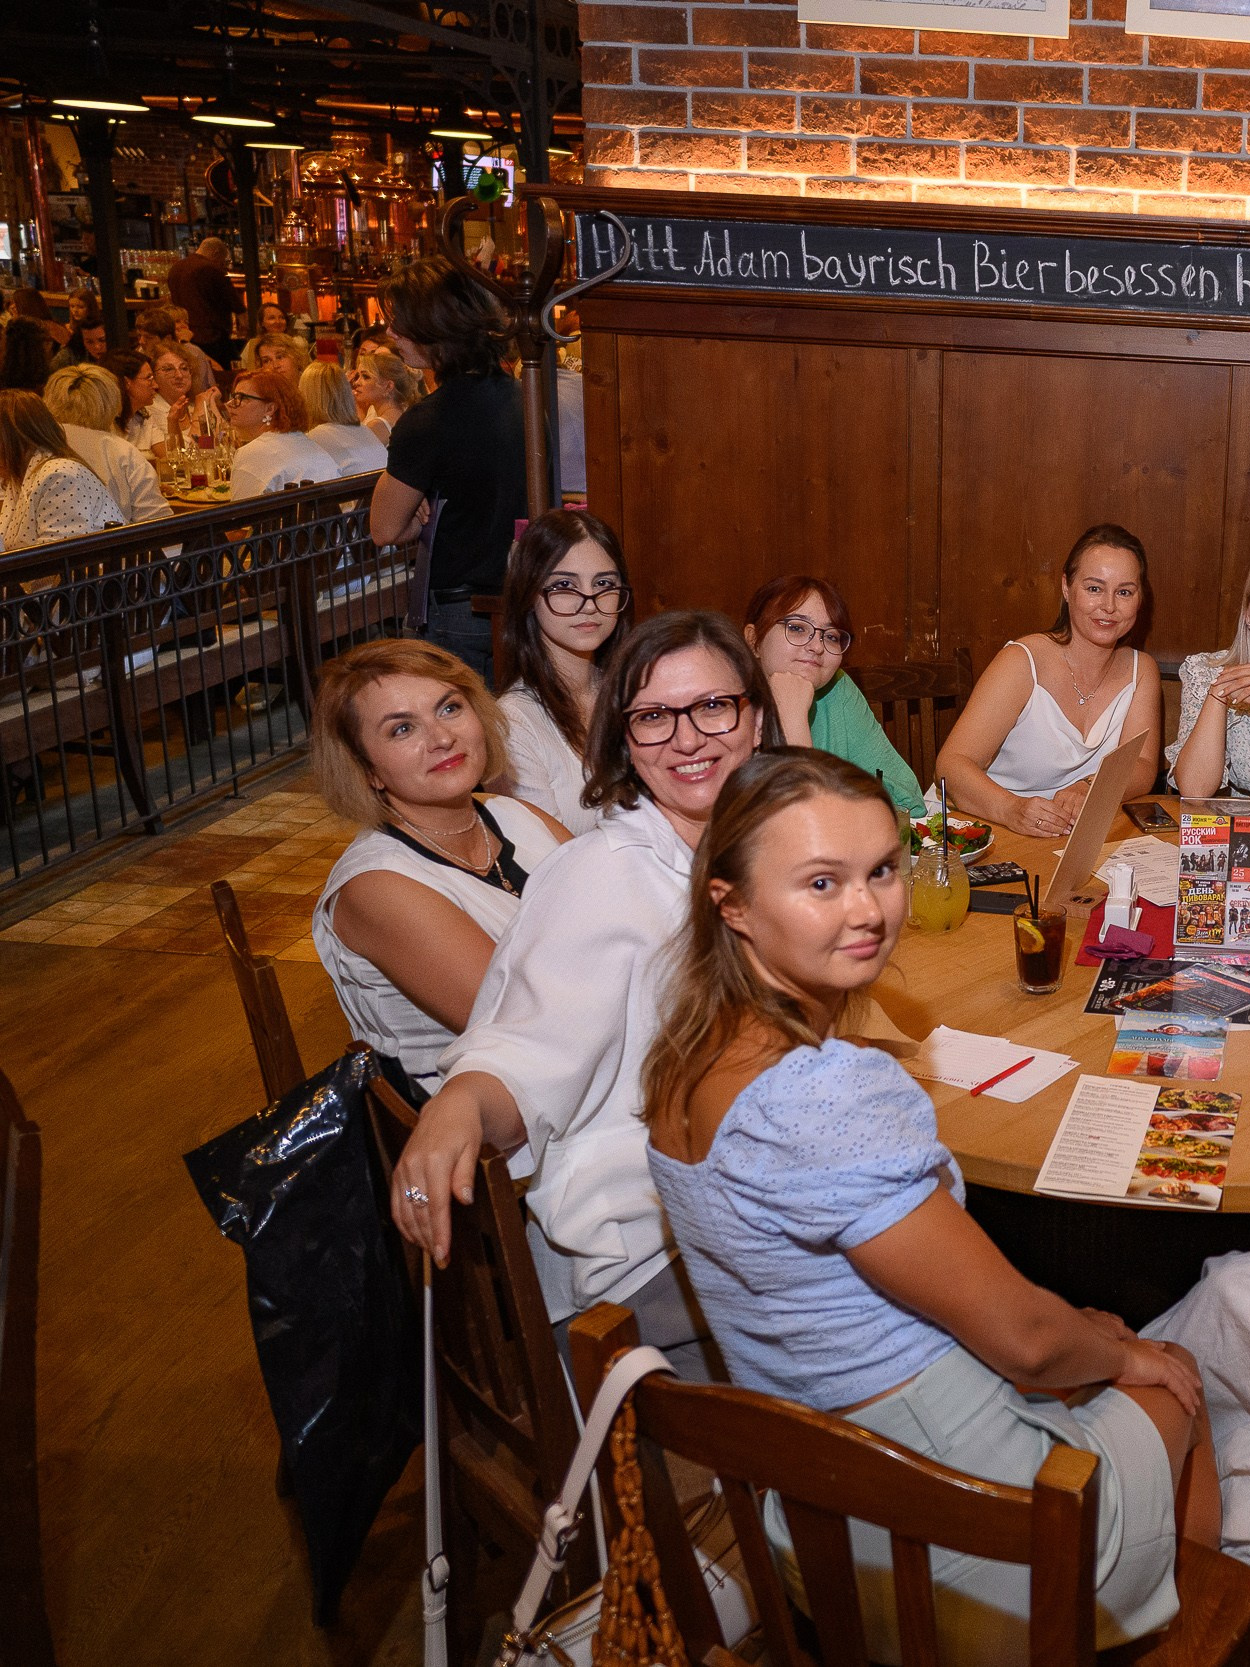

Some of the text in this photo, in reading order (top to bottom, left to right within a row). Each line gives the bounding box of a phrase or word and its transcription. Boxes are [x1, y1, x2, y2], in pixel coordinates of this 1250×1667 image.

[693, 229, 791, 279] Adam
[801, 229, 957, 290] bayrisch
[973, 239, 1058, 293] Bier
[1065, 249, 1219, 300] besessen
[1181, 826, 1217, 836] РУССКИЙ
[1181, 835, 1202, 845] РОК
[1233, 868, 1245, 877] 25
[1188, 887, 1214, 896] ДЕНЬ
[1182, 893, 1225, 903] ПИВОВАРА!
